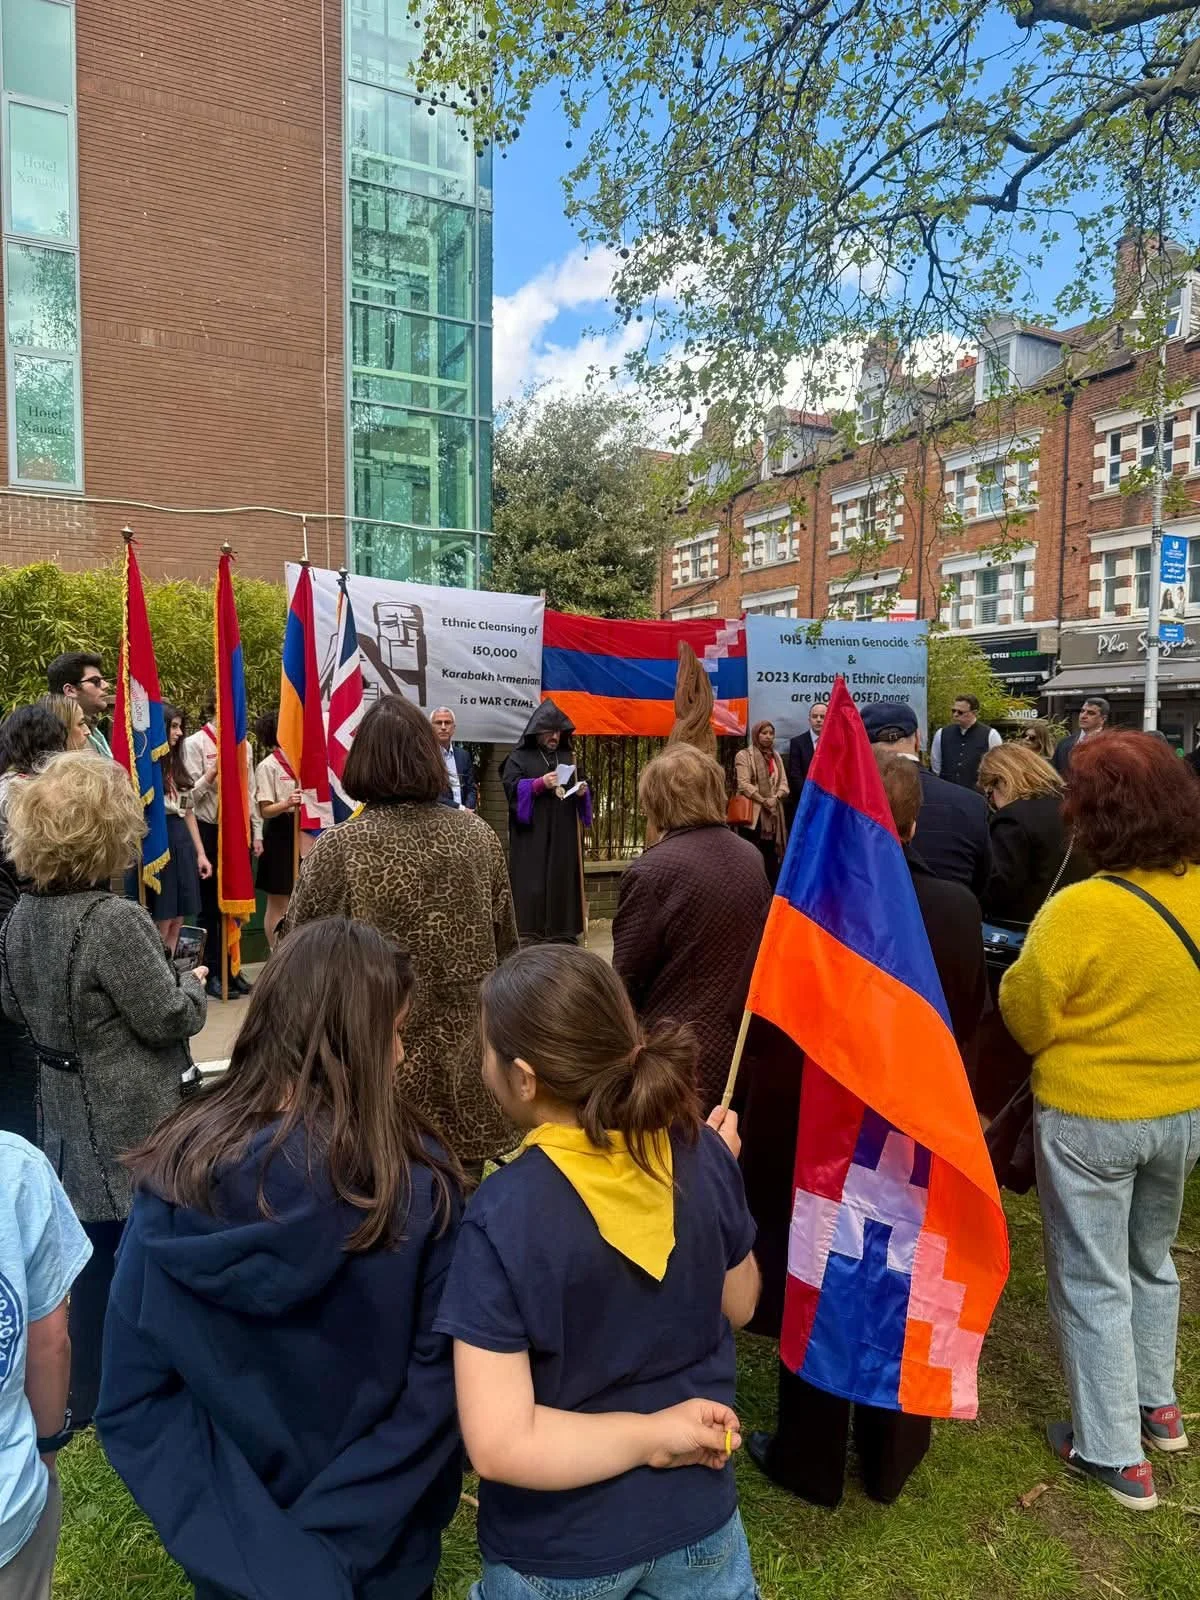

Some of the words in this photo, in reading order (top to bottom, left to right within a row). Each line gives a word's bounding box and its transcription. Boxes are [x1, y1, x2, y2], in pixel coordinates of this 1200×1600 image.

[23, 152, 57, 172] Hotel
[28, 405, 62, 420] Hotel
[23, 420, 69, 437] Xanadu
[442, 617, 477, 629] Ethnic
[478, 621, 527, 636] Cleansing
[528, 625, 539, 635] of
[779, 634, 802, 645] 1915
[805, 635, 860, 648] Armenian
[862, 636, 910, 648] Genocide
[1097, 633, 1129, 655] Pho
[473, 646, 518, 658] 150,000
[847, 654, 857, 665] &
[442, 669, 495, 682] Karabakh
[756, 671, 789, 683] 2023
[852, 672, 885, 684] Ethnic
[460, 695, 469, 705] is
[479, 696, 502, 706] WAR
[791, 693, 811, 703] are
[814, 692, 832, 703] NO
[854, 692, 880, 703] OSED
